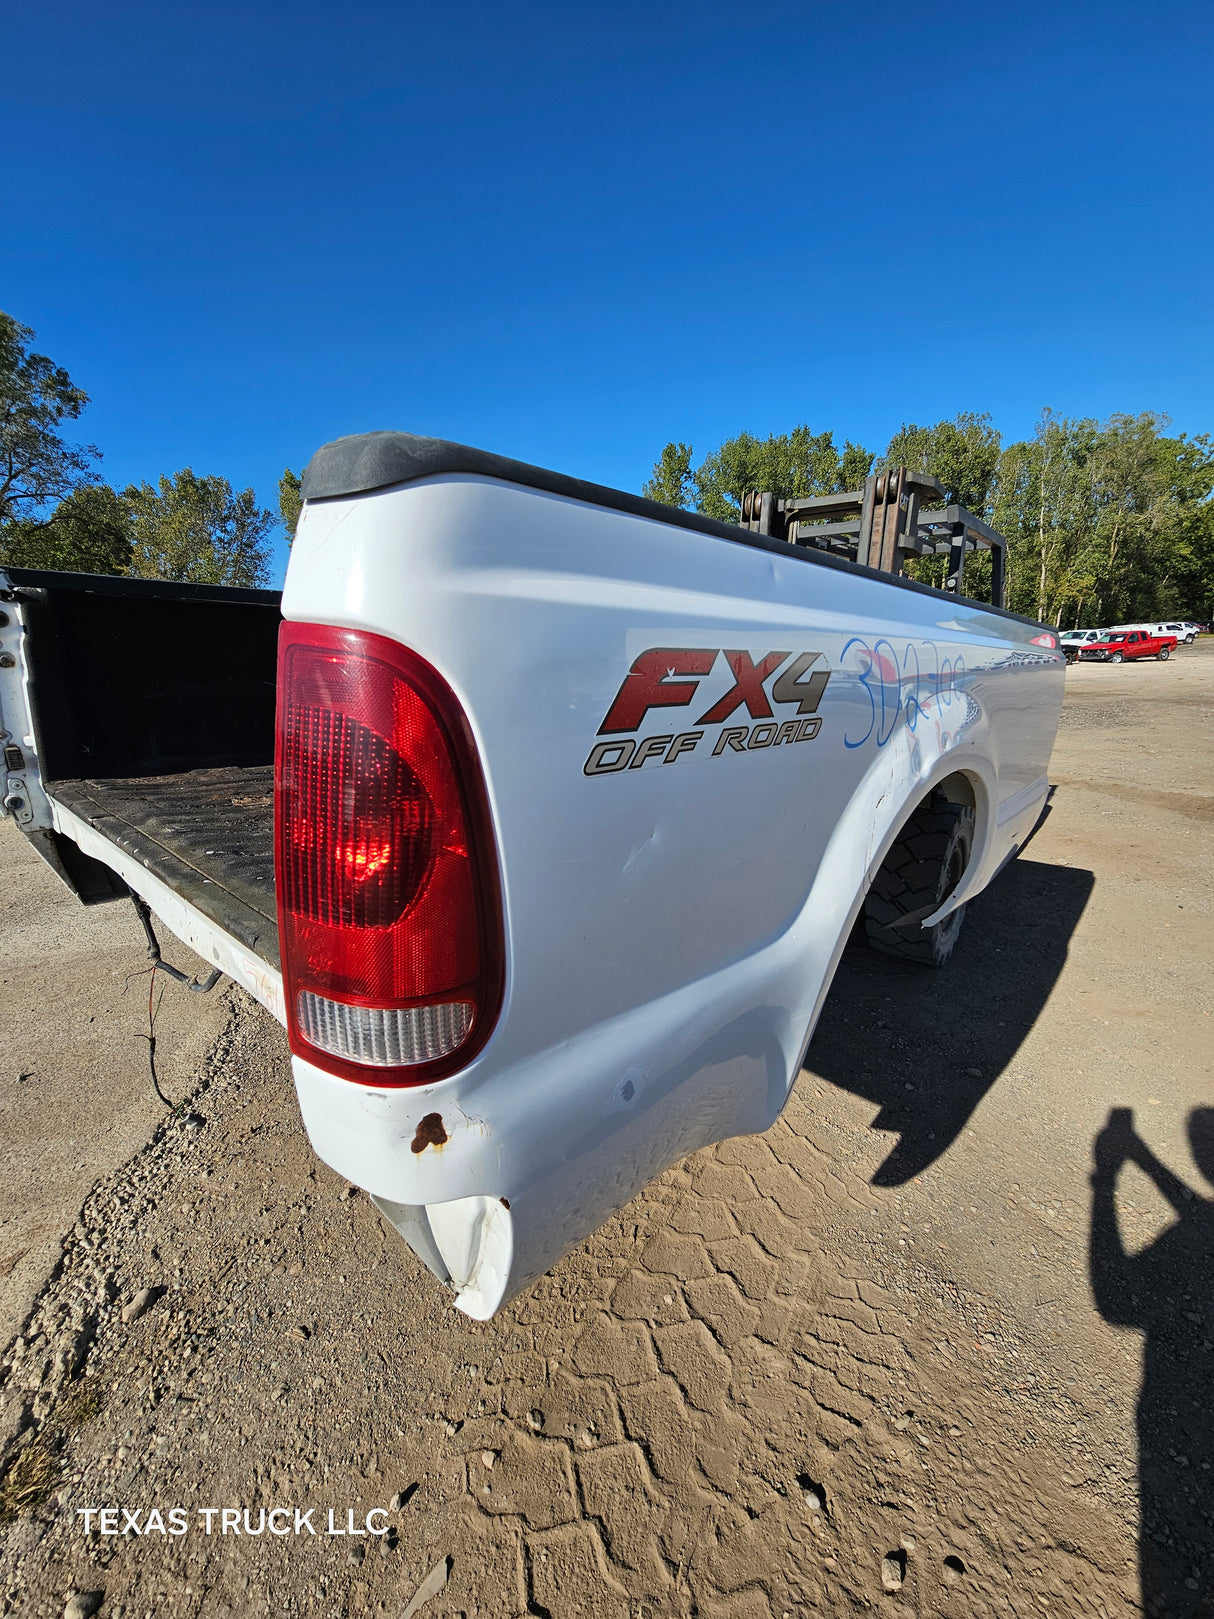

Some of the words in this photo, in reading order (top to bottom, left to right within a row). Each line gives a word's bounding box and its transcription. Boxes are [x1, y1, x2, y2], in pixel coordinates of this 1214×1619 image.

[596, 647, 832, 737] FX4
[583, 731, 705, 776] OFF
[712, 717, 823, 756] ROAD
